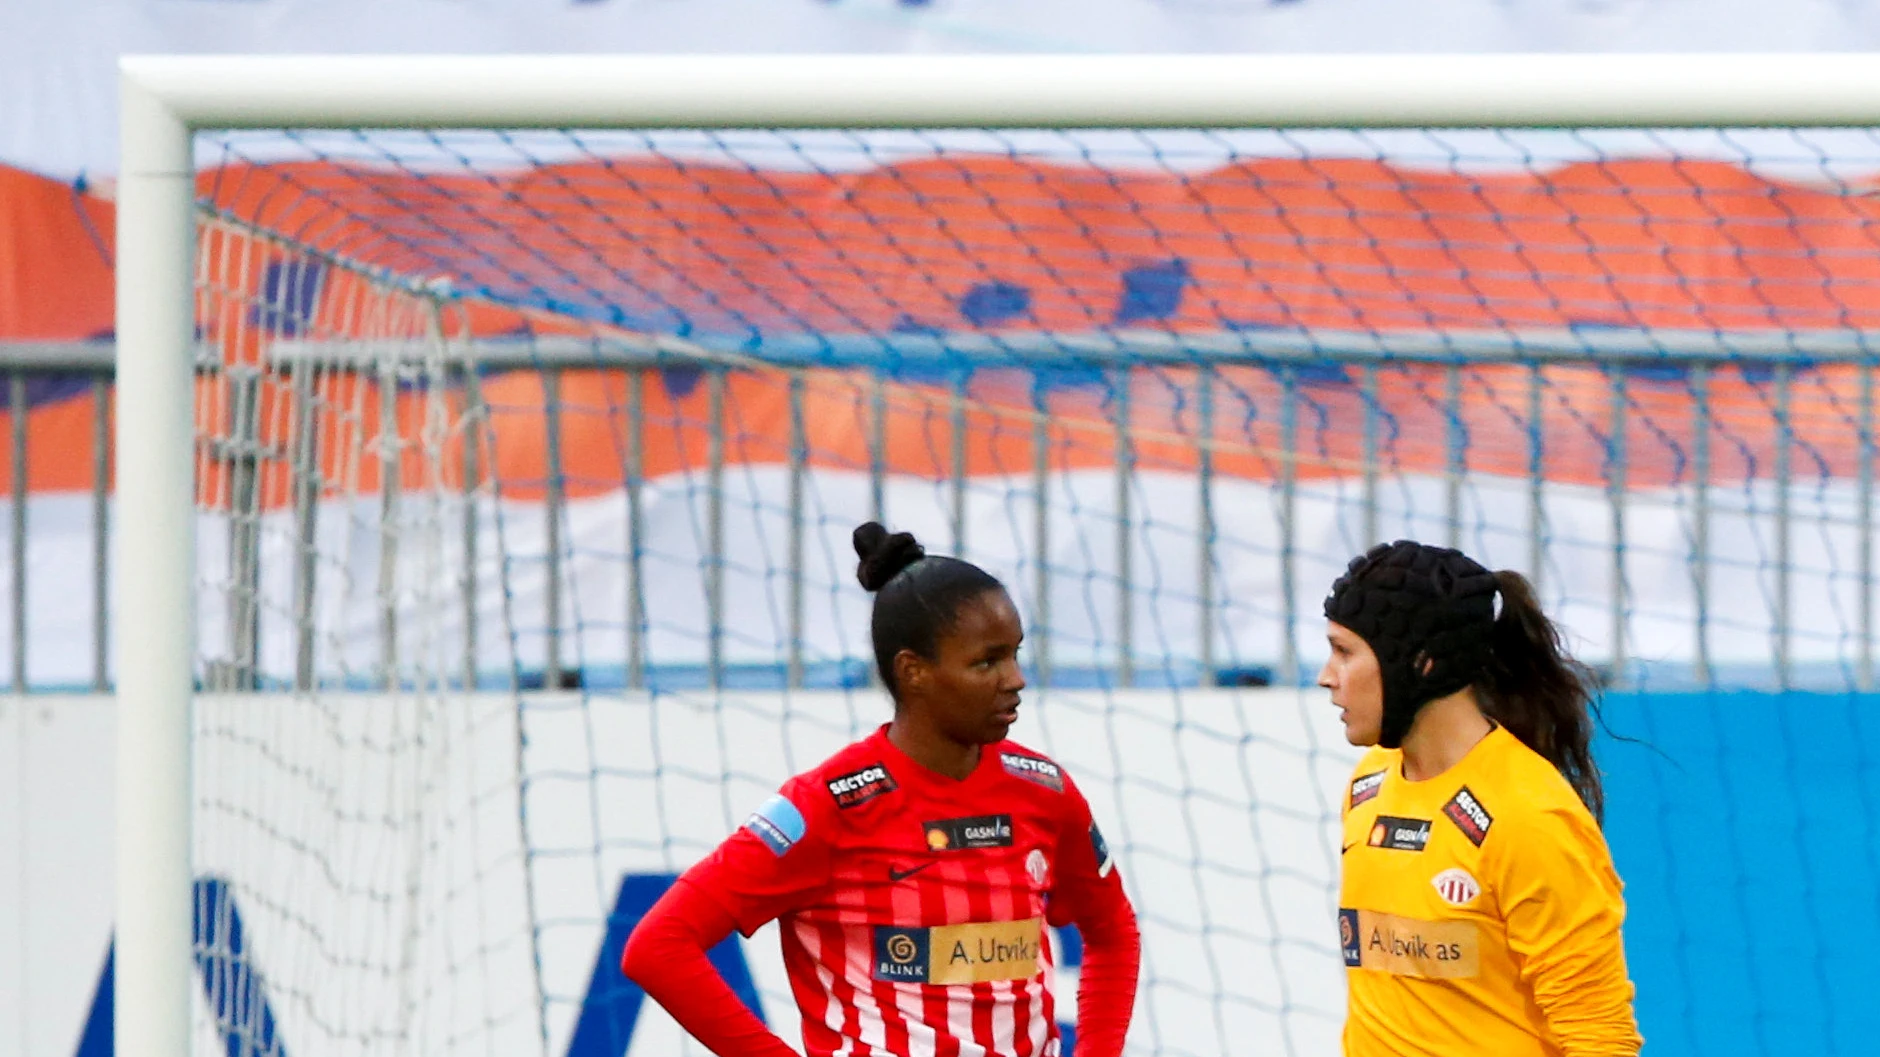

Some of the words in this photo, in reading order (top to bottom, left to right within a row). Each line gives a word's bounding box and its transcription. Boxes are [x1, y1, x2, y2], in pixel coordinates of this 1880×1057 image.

[1000, 754, 1058, 777] SECTOR
[829, 767, 886, 795] SECTOR
[1455, 791, 1490, 832] SECTOR
[979, 935, 1028, 963] Utvik
[1436, 942, 1461, 961] as
[880, 963, 924, 976] BLINK
